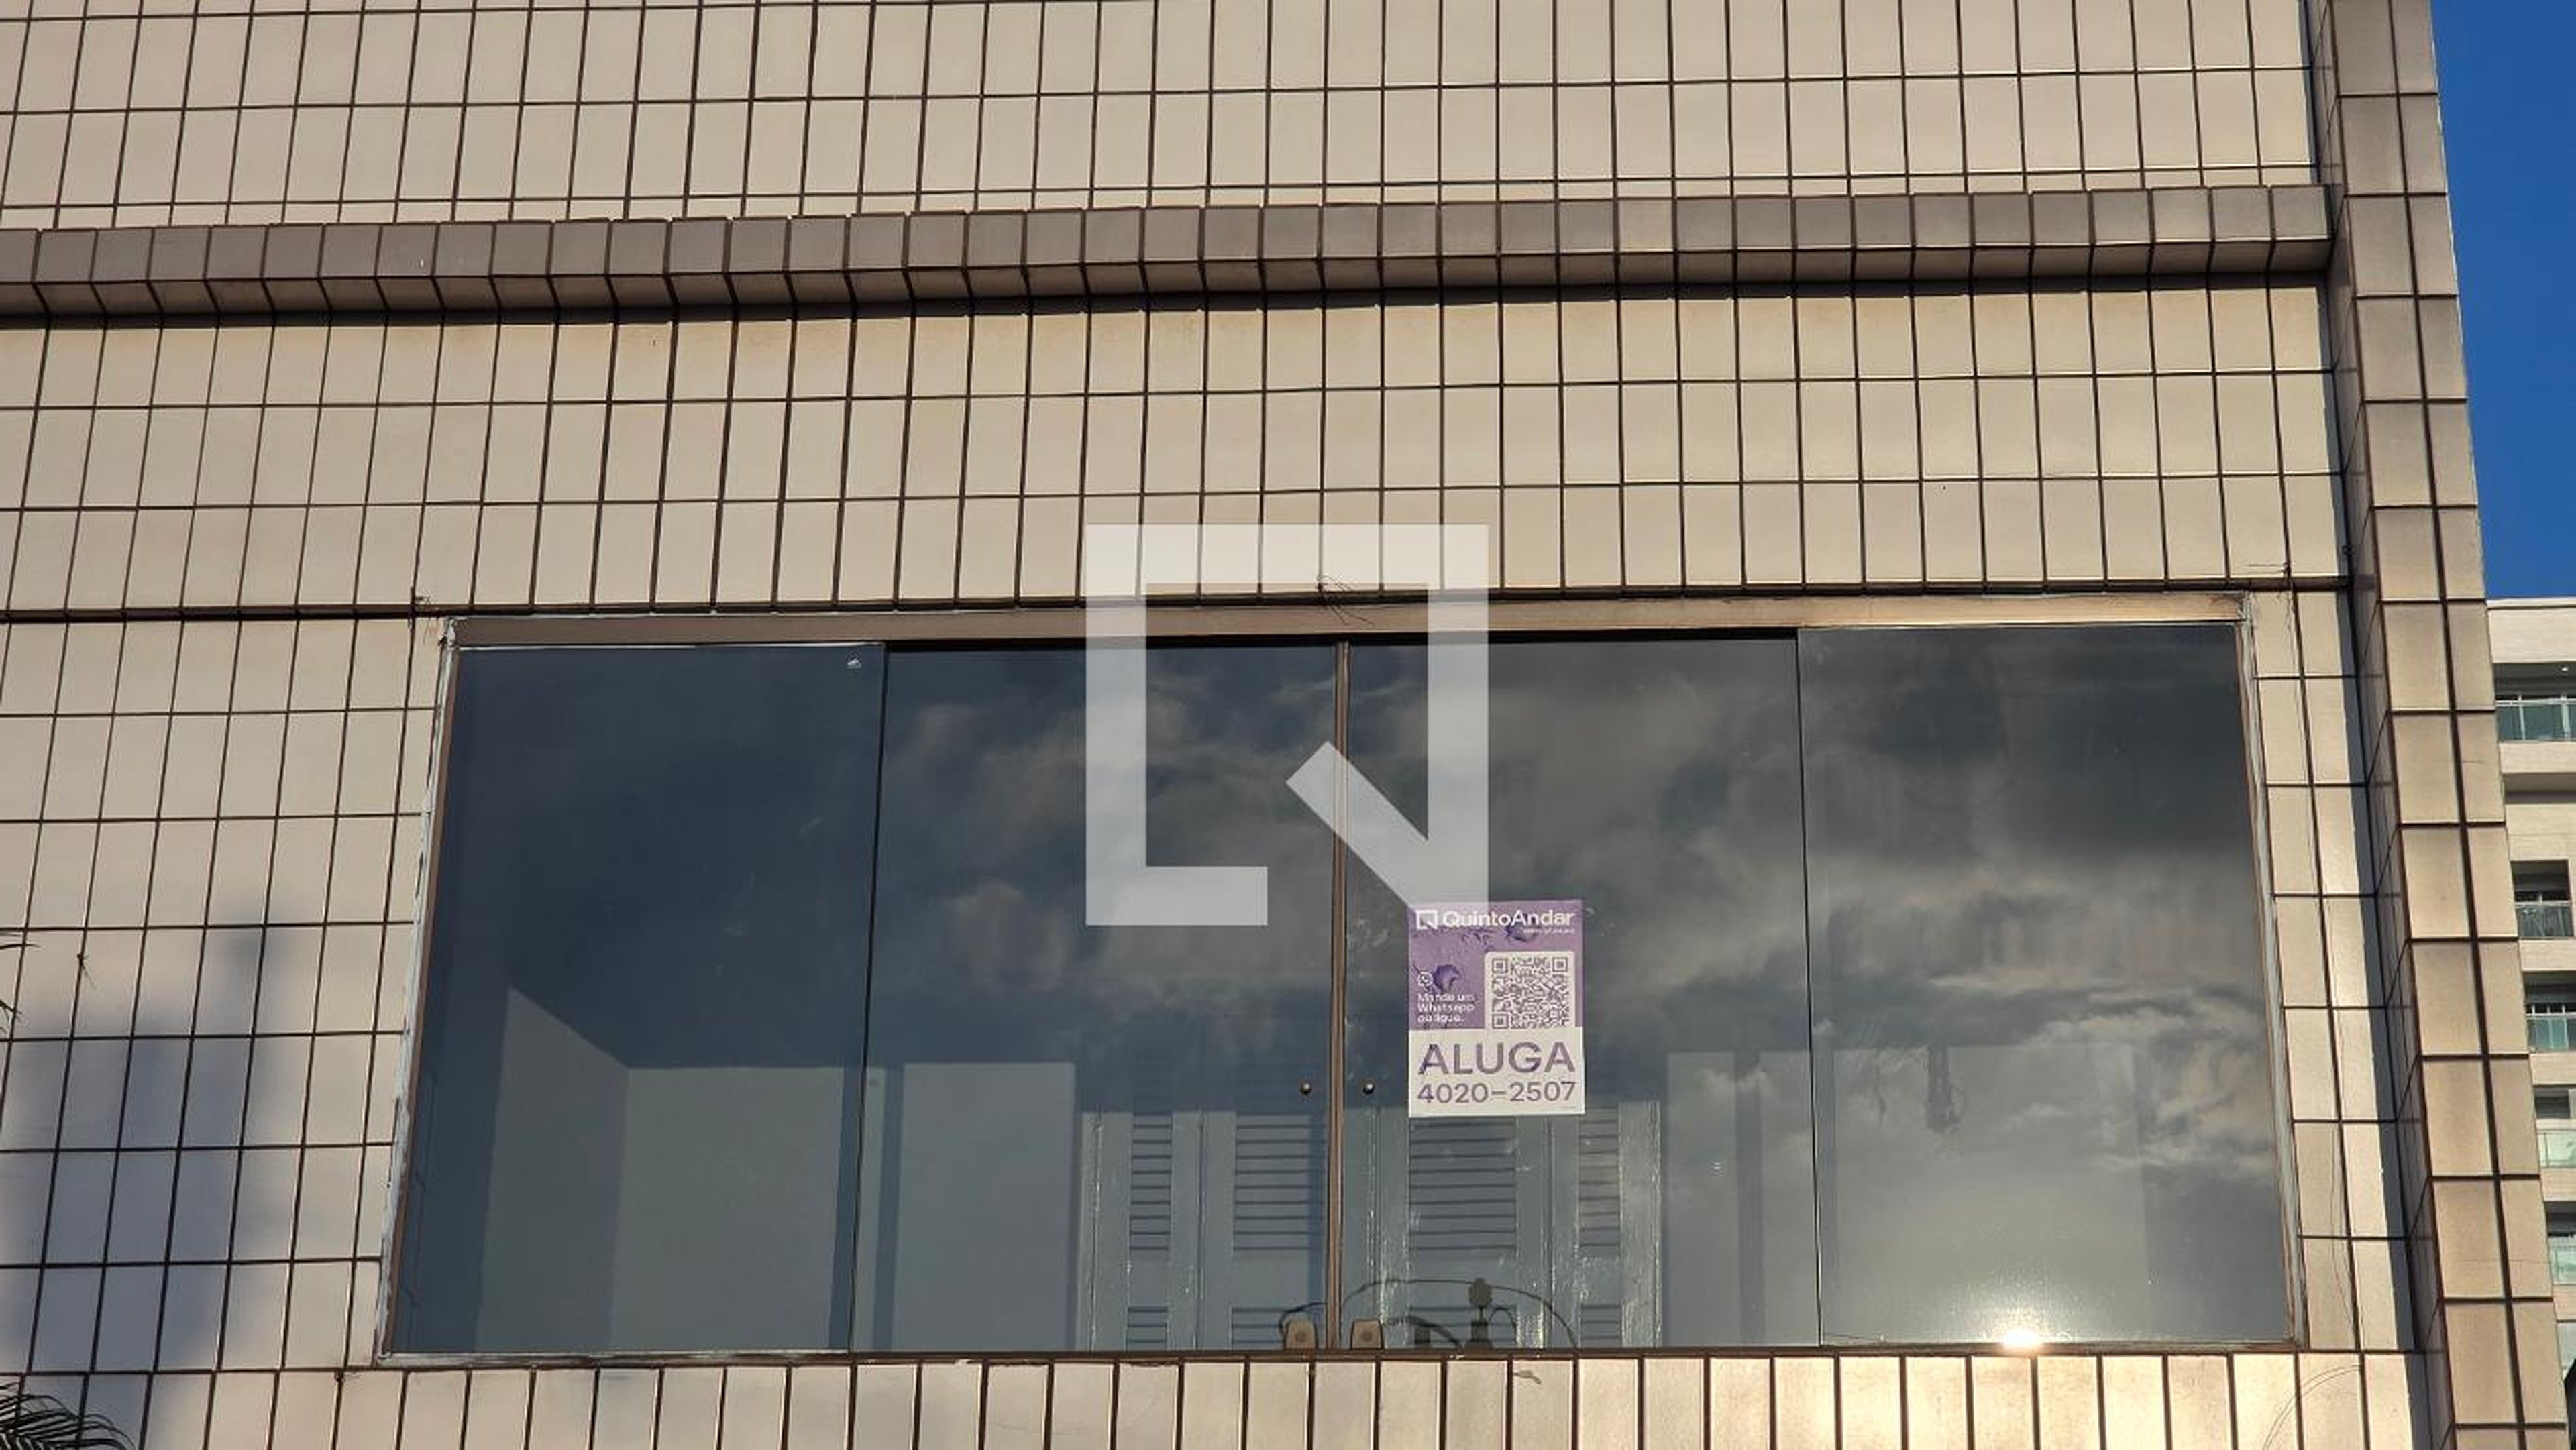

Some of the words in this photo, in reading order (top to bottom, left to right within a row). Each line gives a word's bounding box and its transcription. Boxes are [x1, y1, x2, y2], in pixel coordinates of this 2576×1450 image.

[1442, 909, 1574, 928] QuintoAndar
[1418, 1042, 1576, 1074] ALUGA
[1417, 1081, 1577, 1103] 4020-2507
